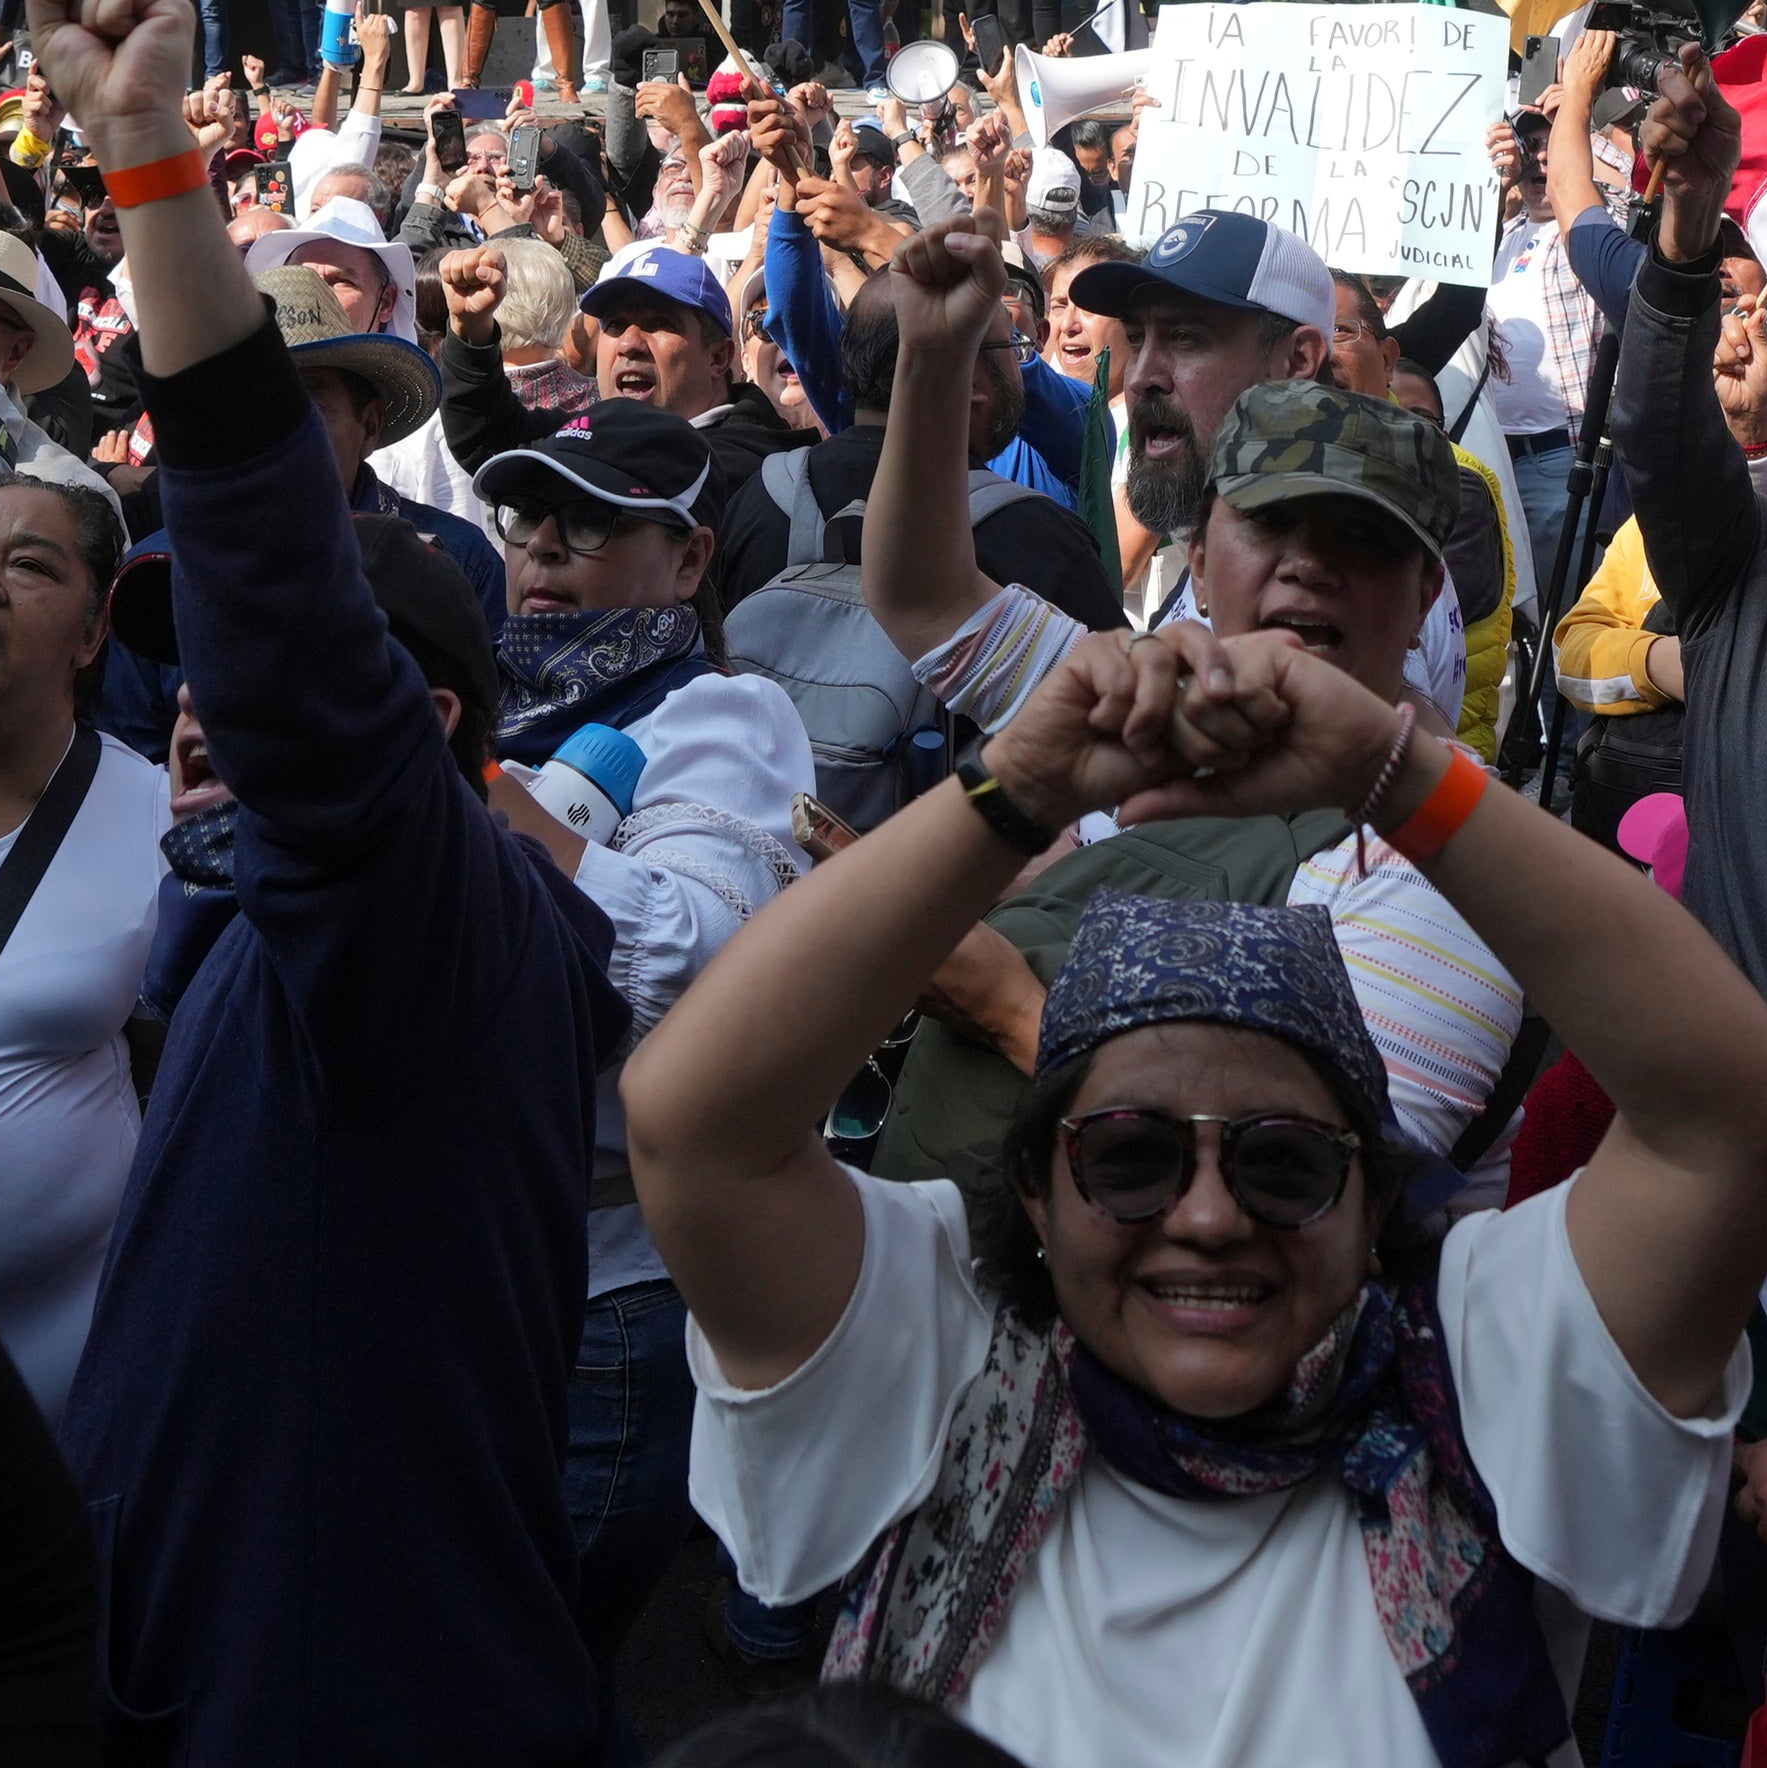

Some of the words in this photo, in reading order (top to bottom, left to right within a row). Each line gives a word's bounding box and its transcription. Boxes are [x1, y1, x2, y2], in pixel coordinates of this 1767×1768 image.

[1309, 15, 1416, 53] FAVOR!
[1443, 20, 1475, 50] DE
[1309, 54, 1346, 73] LA
[1162, 58, 1484, 156] INVALIDEZ
[1233, 149, 1278, 177] DE
[1330, 160, 1368, 178] LA
[627, 252, 659, 277] L
[1388, 241, 1475, 271] JUDICIAL
[555, 427, 593, 441] adidas
